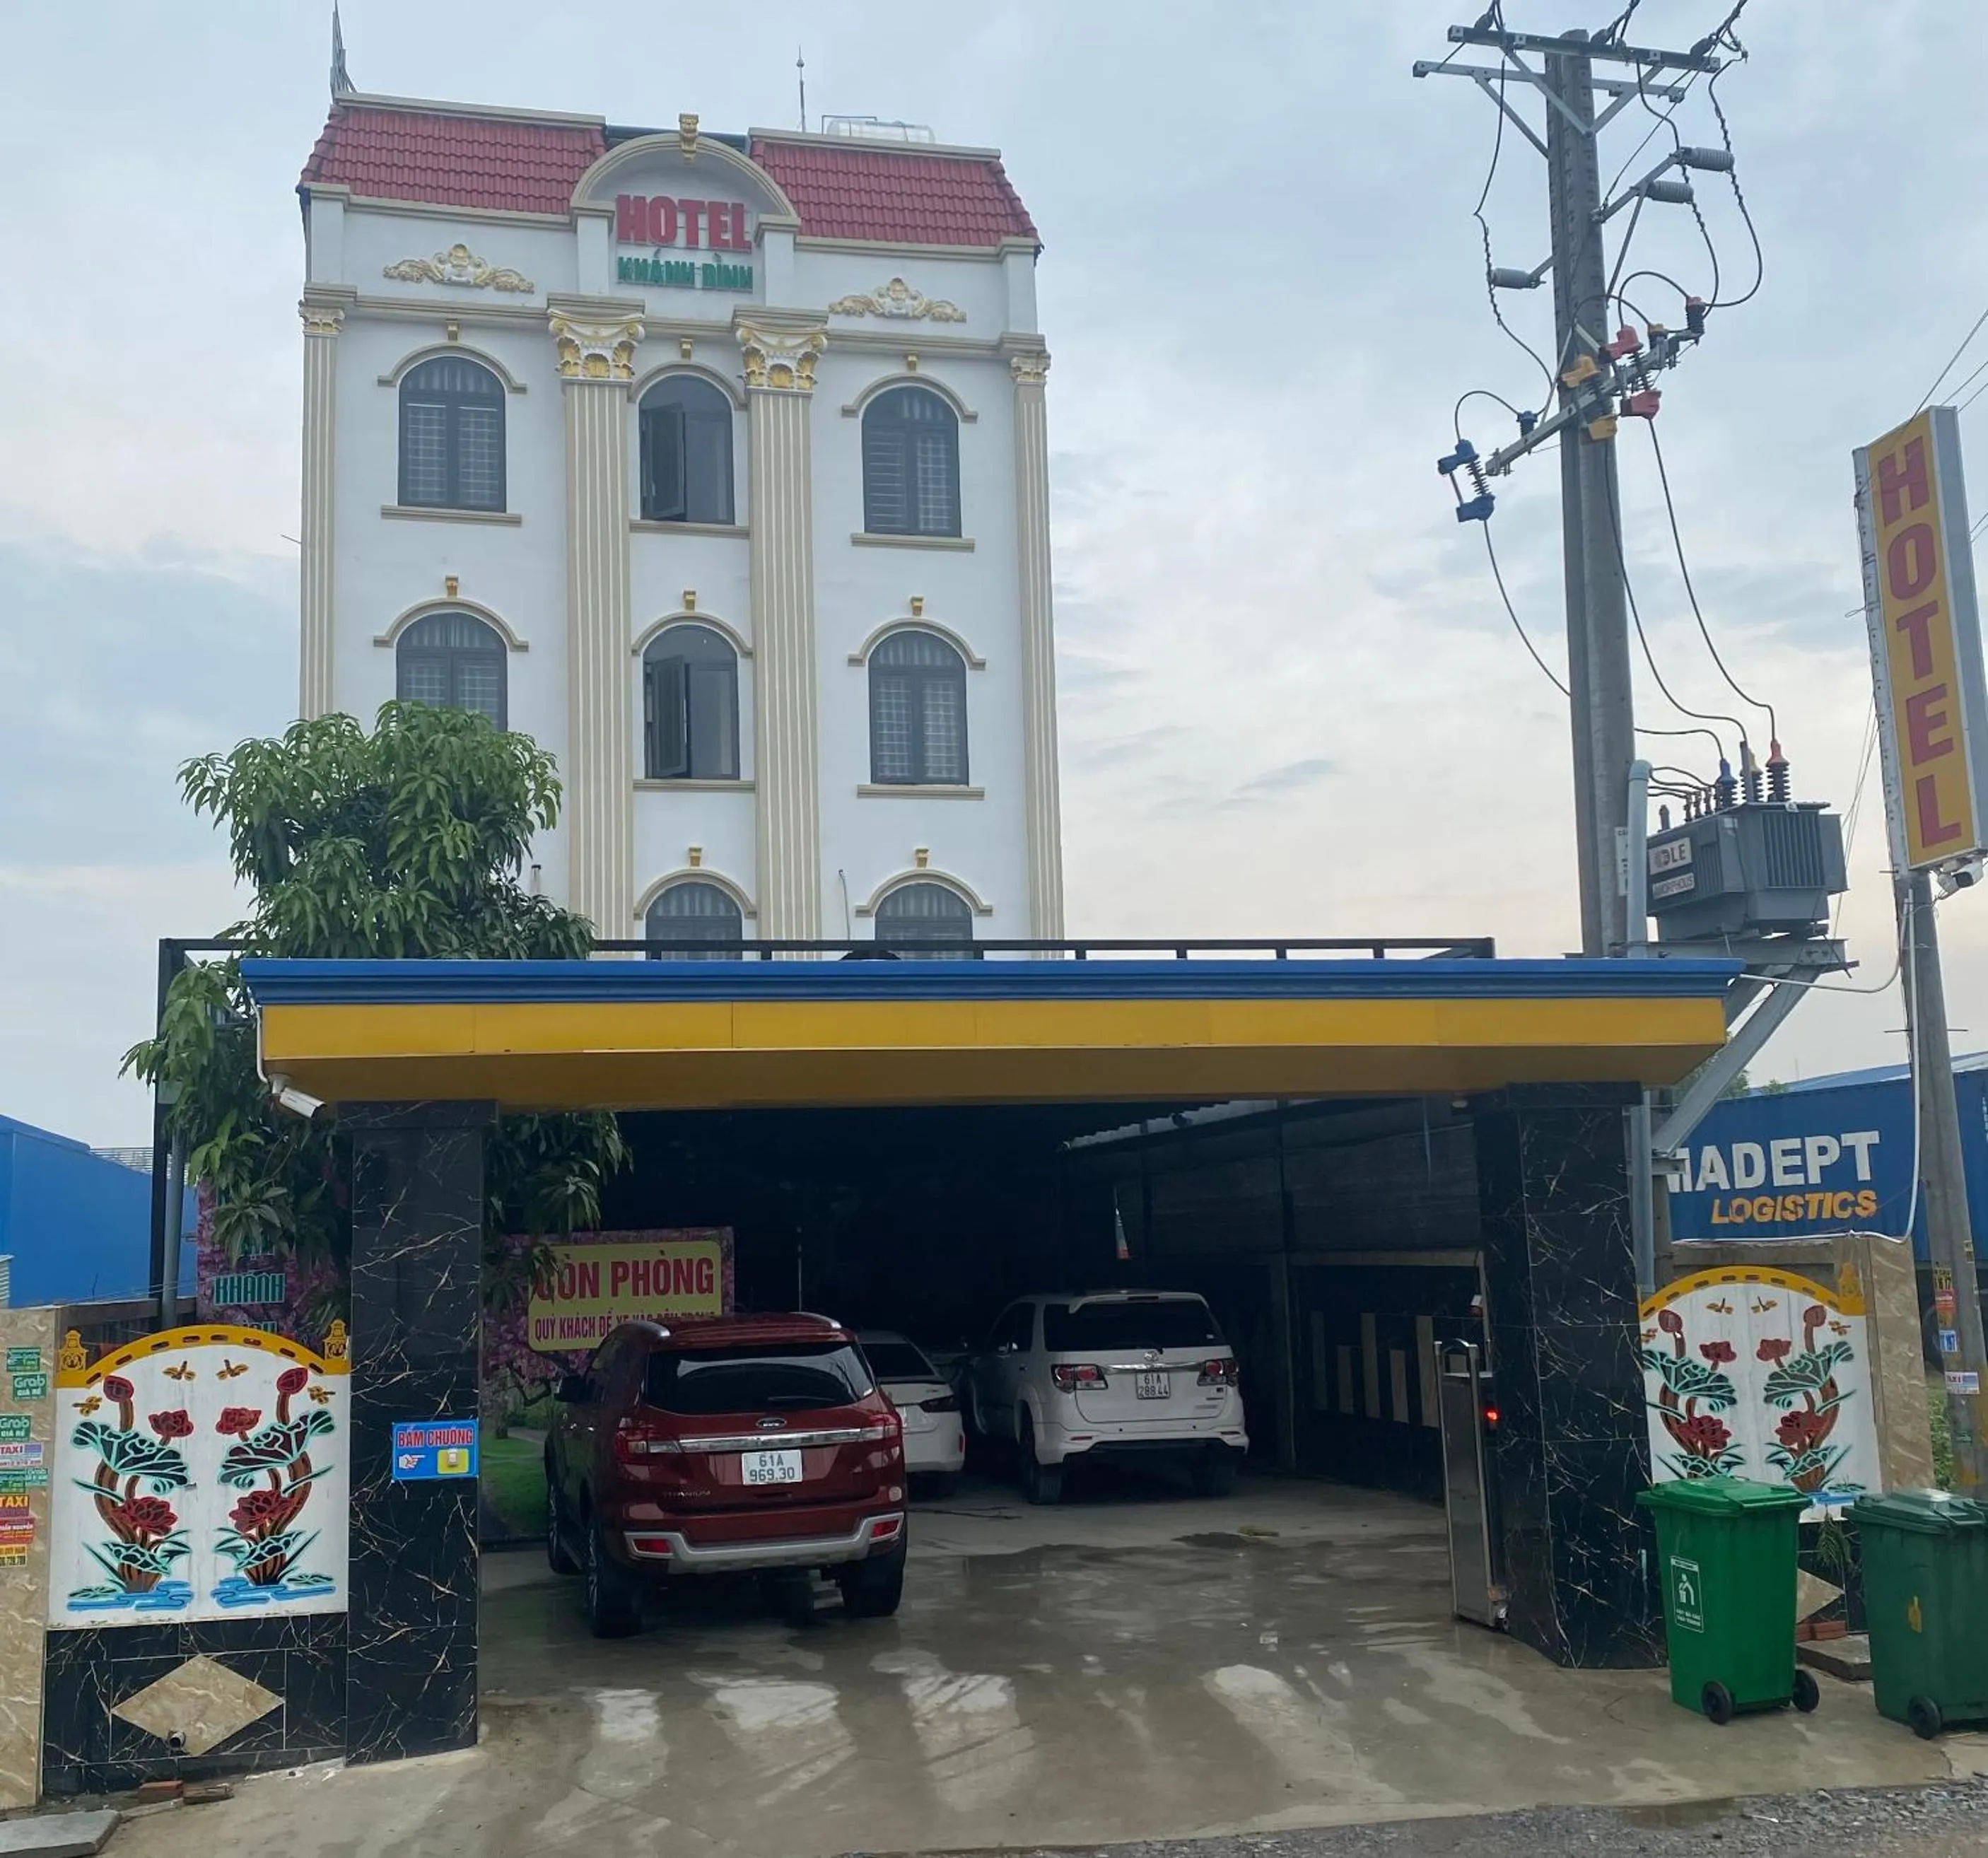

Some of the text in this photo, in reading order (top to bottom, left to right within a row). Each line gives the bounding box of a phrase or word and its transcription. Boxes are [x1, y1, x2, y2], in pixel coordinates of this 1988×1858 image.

[616, 194, 752, 253] HOTEL
[1878, 435, 1963, 850] HOTEL
[1710, 1189, 1878, 1225] LOGISTICS
[610, 1250, 714, 1297] PHÒNG
[560, 1312, 595, 1338] KHÁCH
[14, 1374, 45, 1388] Grab
[1144, 1373, 1162, 1385] 61A
[0, 1417, 30, 1429] Grab
[0, 1445, 23, 1454] TAXI
[759, 1454, 784, 1467] 61A
[749, 1466, 795, 1483] 969.30
[0, 1495, 28, 1508] TAXI
